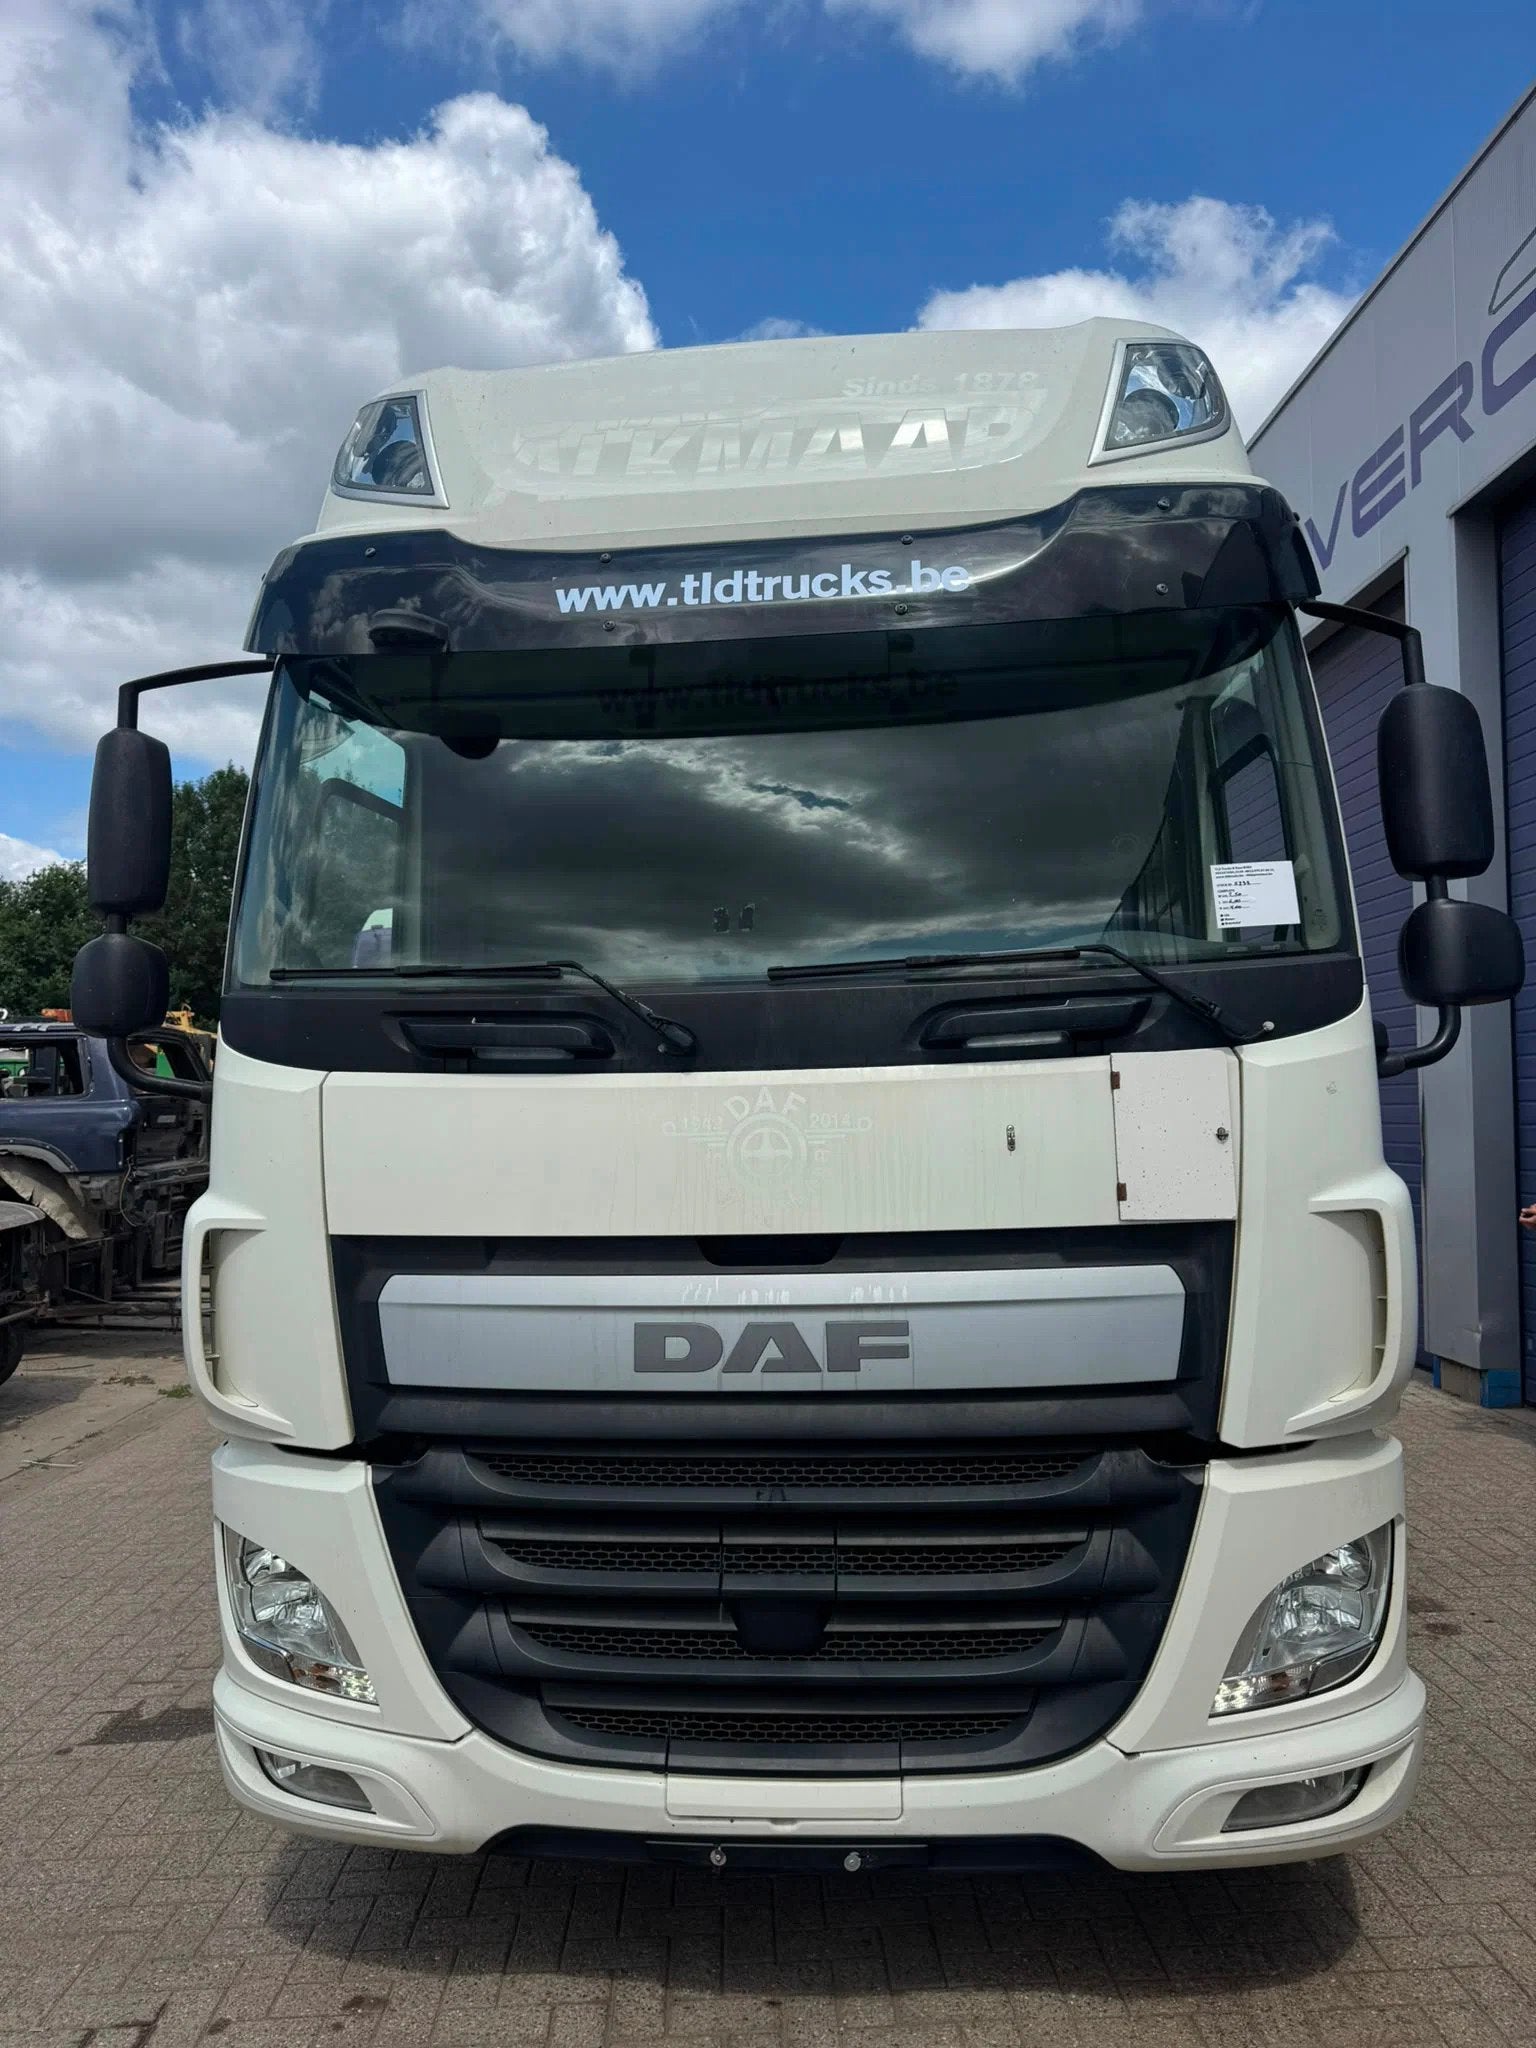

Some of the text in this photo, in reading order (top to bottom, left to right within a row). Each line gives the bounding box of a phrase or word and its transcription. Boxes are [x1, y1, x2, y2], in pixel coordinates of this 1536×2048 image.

[555, 561, 969, 613] www.tldtrucks.be
[725, 1086, 807, 1121] DAF
[634, 1320, 909, 1372] DAF
